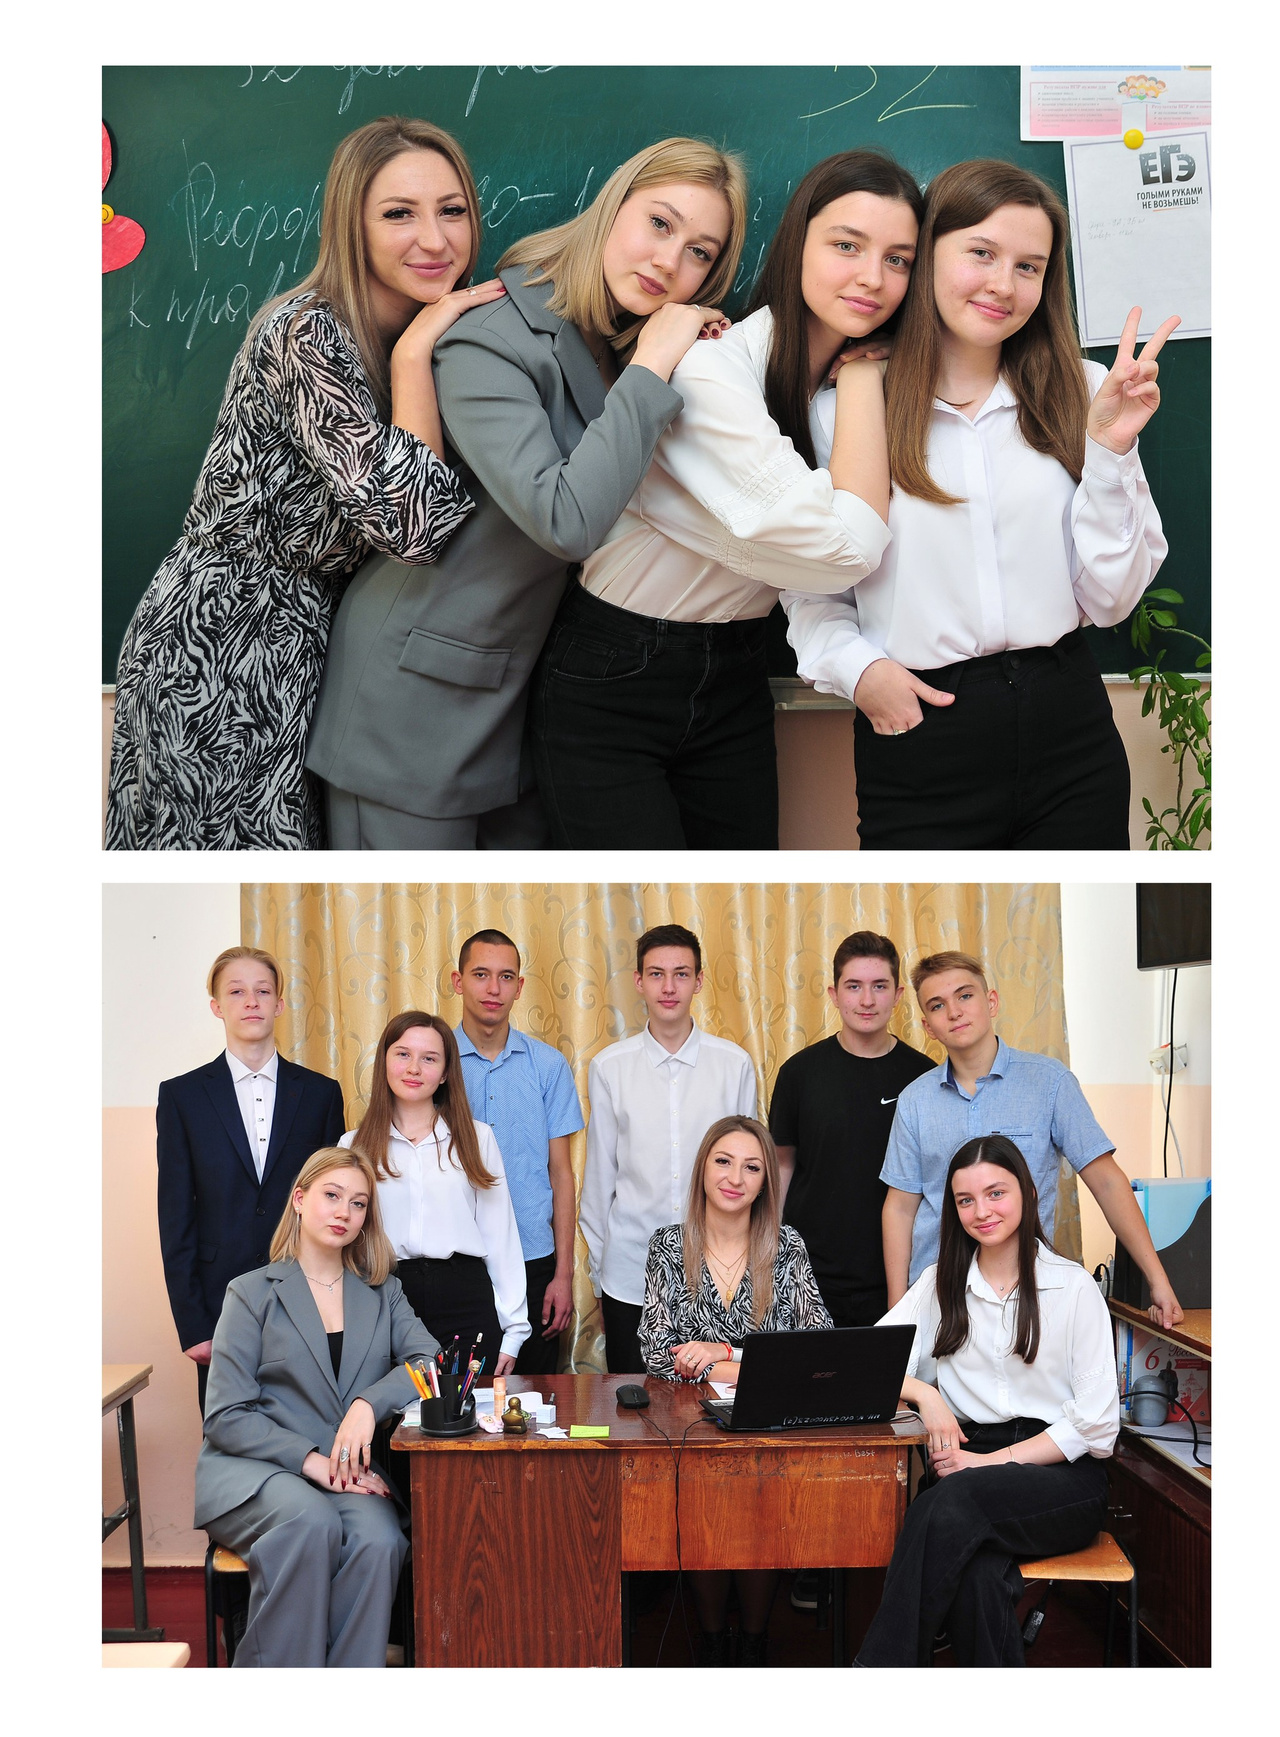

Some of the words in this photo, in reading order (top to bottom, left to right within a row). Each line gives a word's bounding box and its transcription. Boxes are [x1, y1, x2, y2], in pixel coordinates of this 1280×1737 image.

[1138, 144, 1196, 185] ЕГЭ
[1136, 189, 1170, 200] ГОЛЫМИ
[1171, 186, 1203, 198] РУКАМИ
[1142, 200, 1152, 209] НЕ
[1153, 197, 1199, 209] ВОЗЬМЕШЬ!
[1144, 1347, 1162, 1370] 6
[812, 1371, 837, 1379] acer
